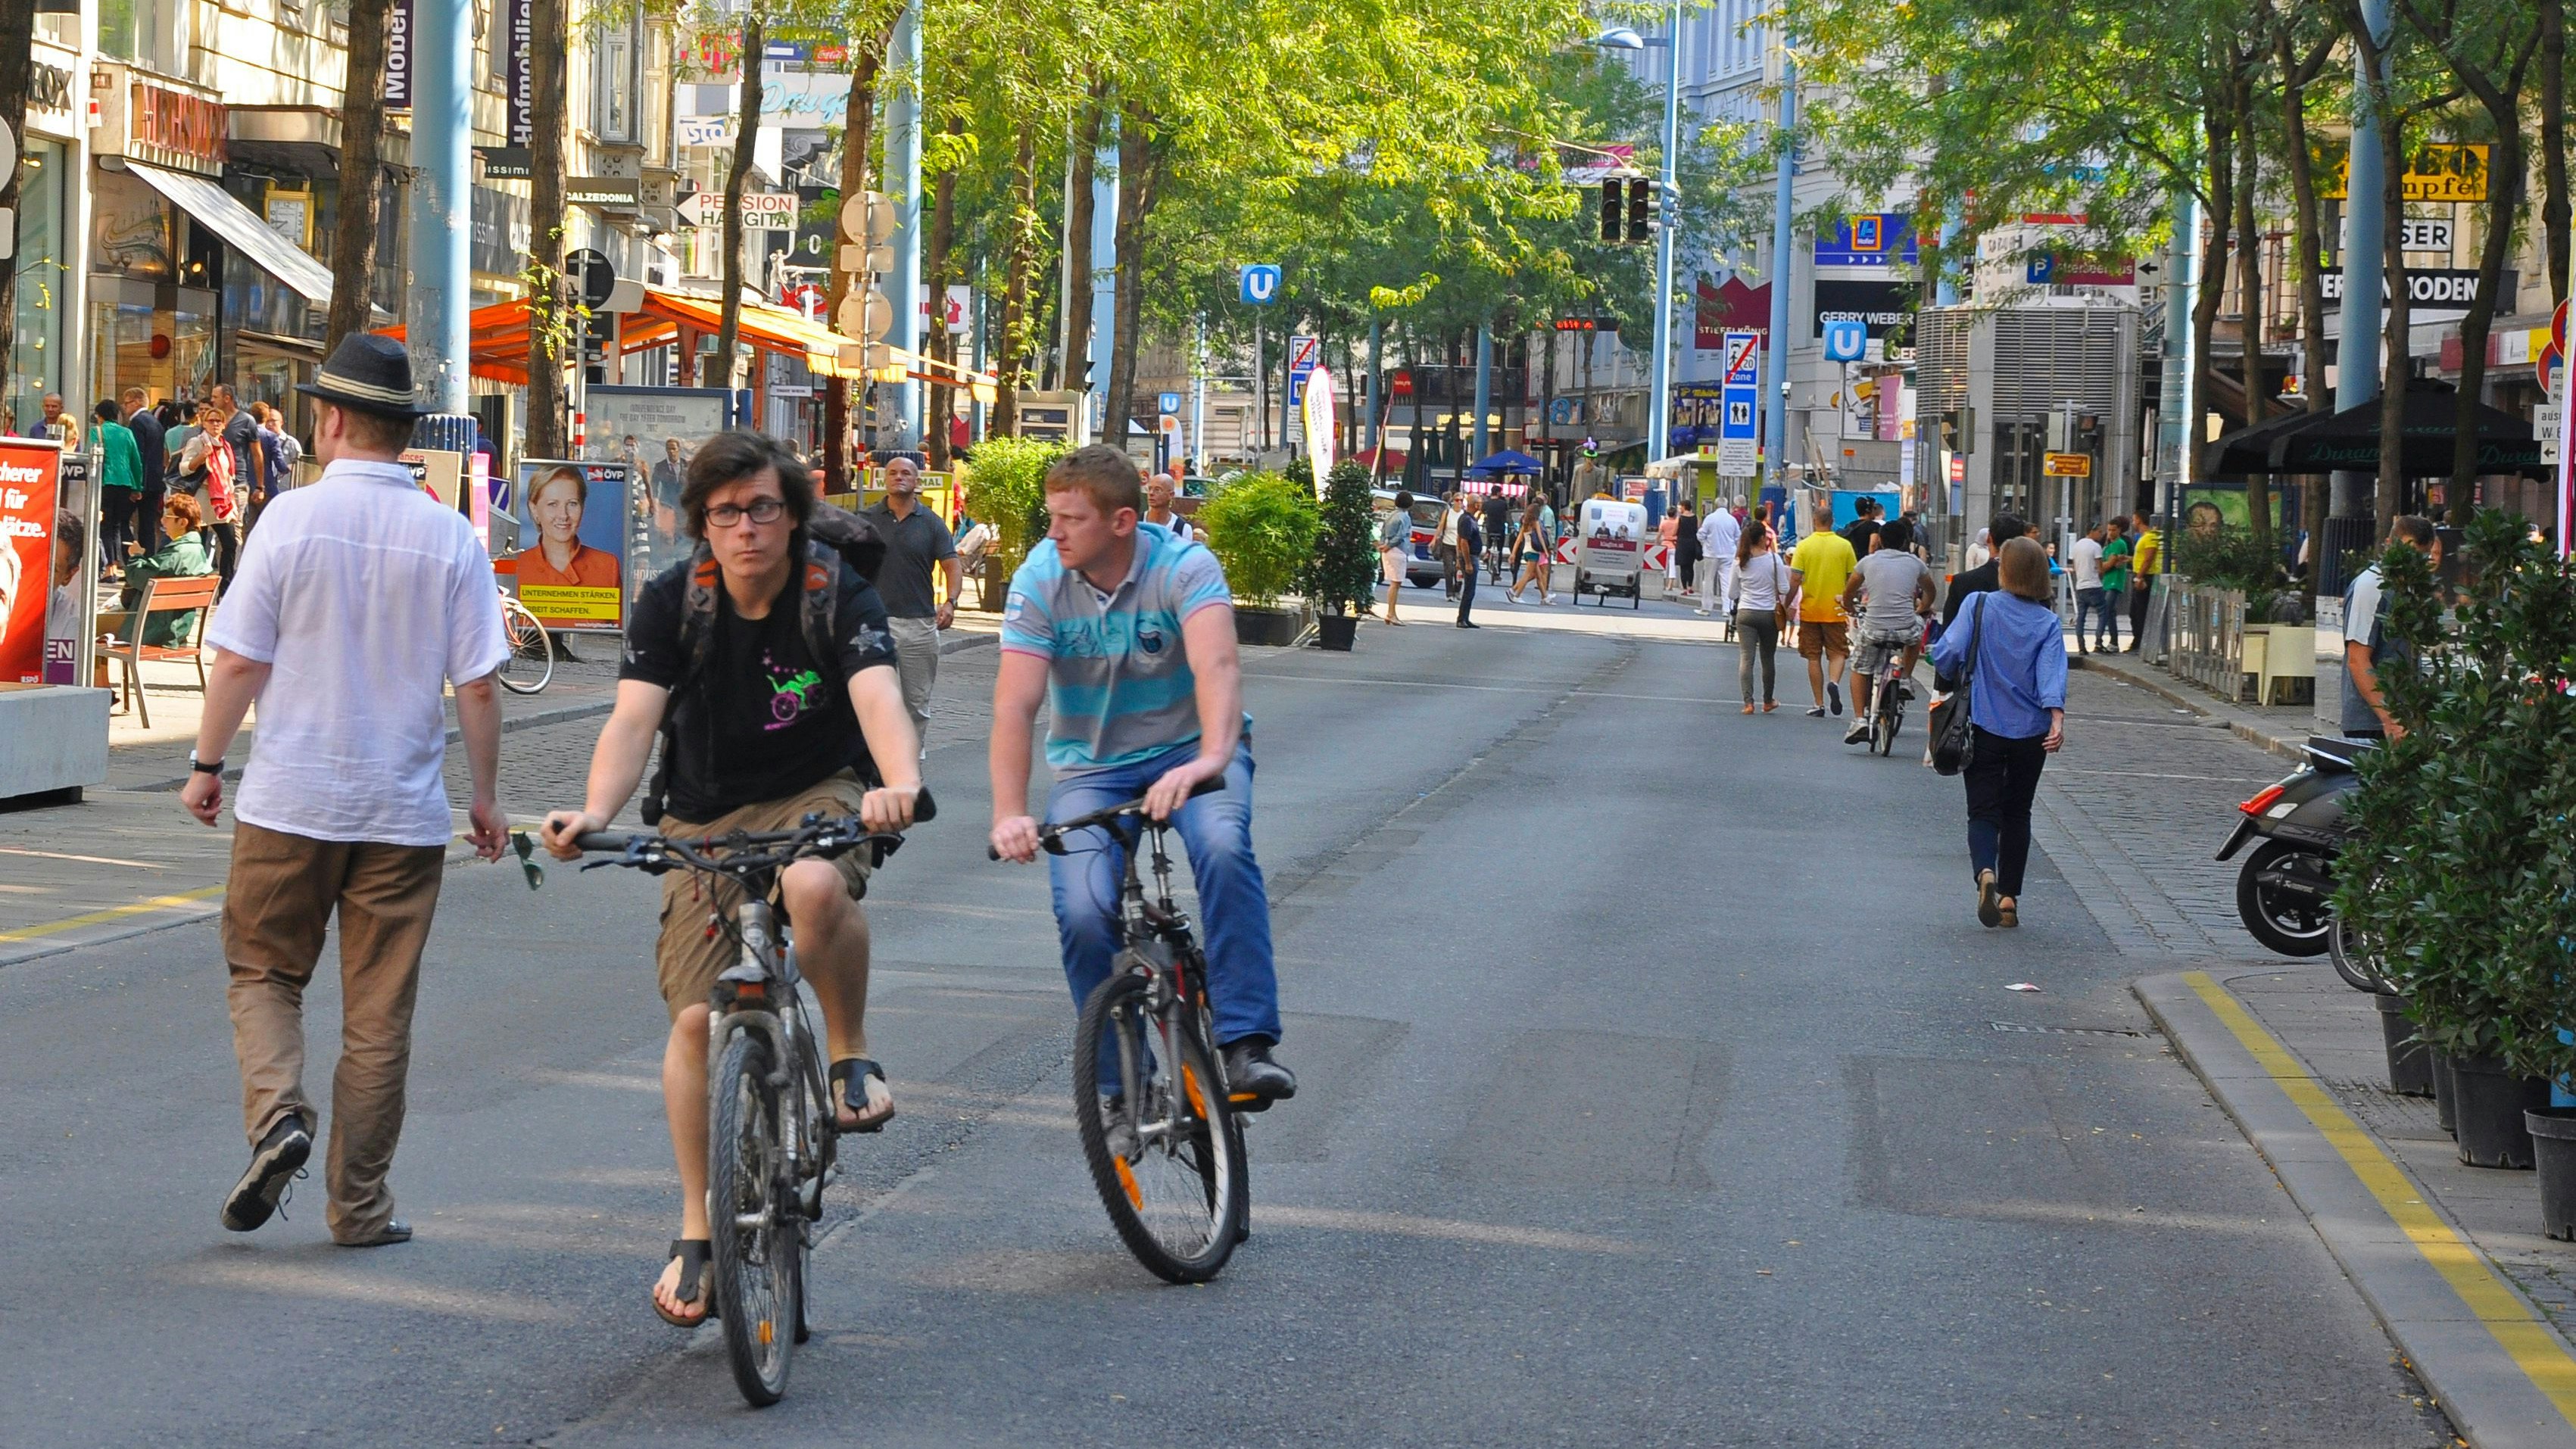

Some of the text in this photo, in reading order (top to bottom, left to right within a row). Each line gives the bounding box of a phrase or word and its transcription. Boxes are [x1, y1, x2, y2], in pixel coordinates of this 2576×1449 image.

[513, 0, 532, 149] Hofmobilie
[566, 192, 635, 204] CALZEDONIA
[700, 195, 792, 211] PESION
[701, 210, 791, 228] HAGITA
[1249, 273, 1274, 300] U
[1866, 313, 1914, 325] WEBER
[1834, 329, 1860, 357] U
[1743, 359, 1754, 369] 20
[1730, 372, 1752, 382] Zone
[1165, 397, 1177, 411] U
[409, 465, 426, 478] VP
[603, 469, 625, 480] ÖVP
[522, 589, 617, 600] UNTERNEHMEN STÄRKEN.
[549, 606, 591, 615] SCHAFFEN.
